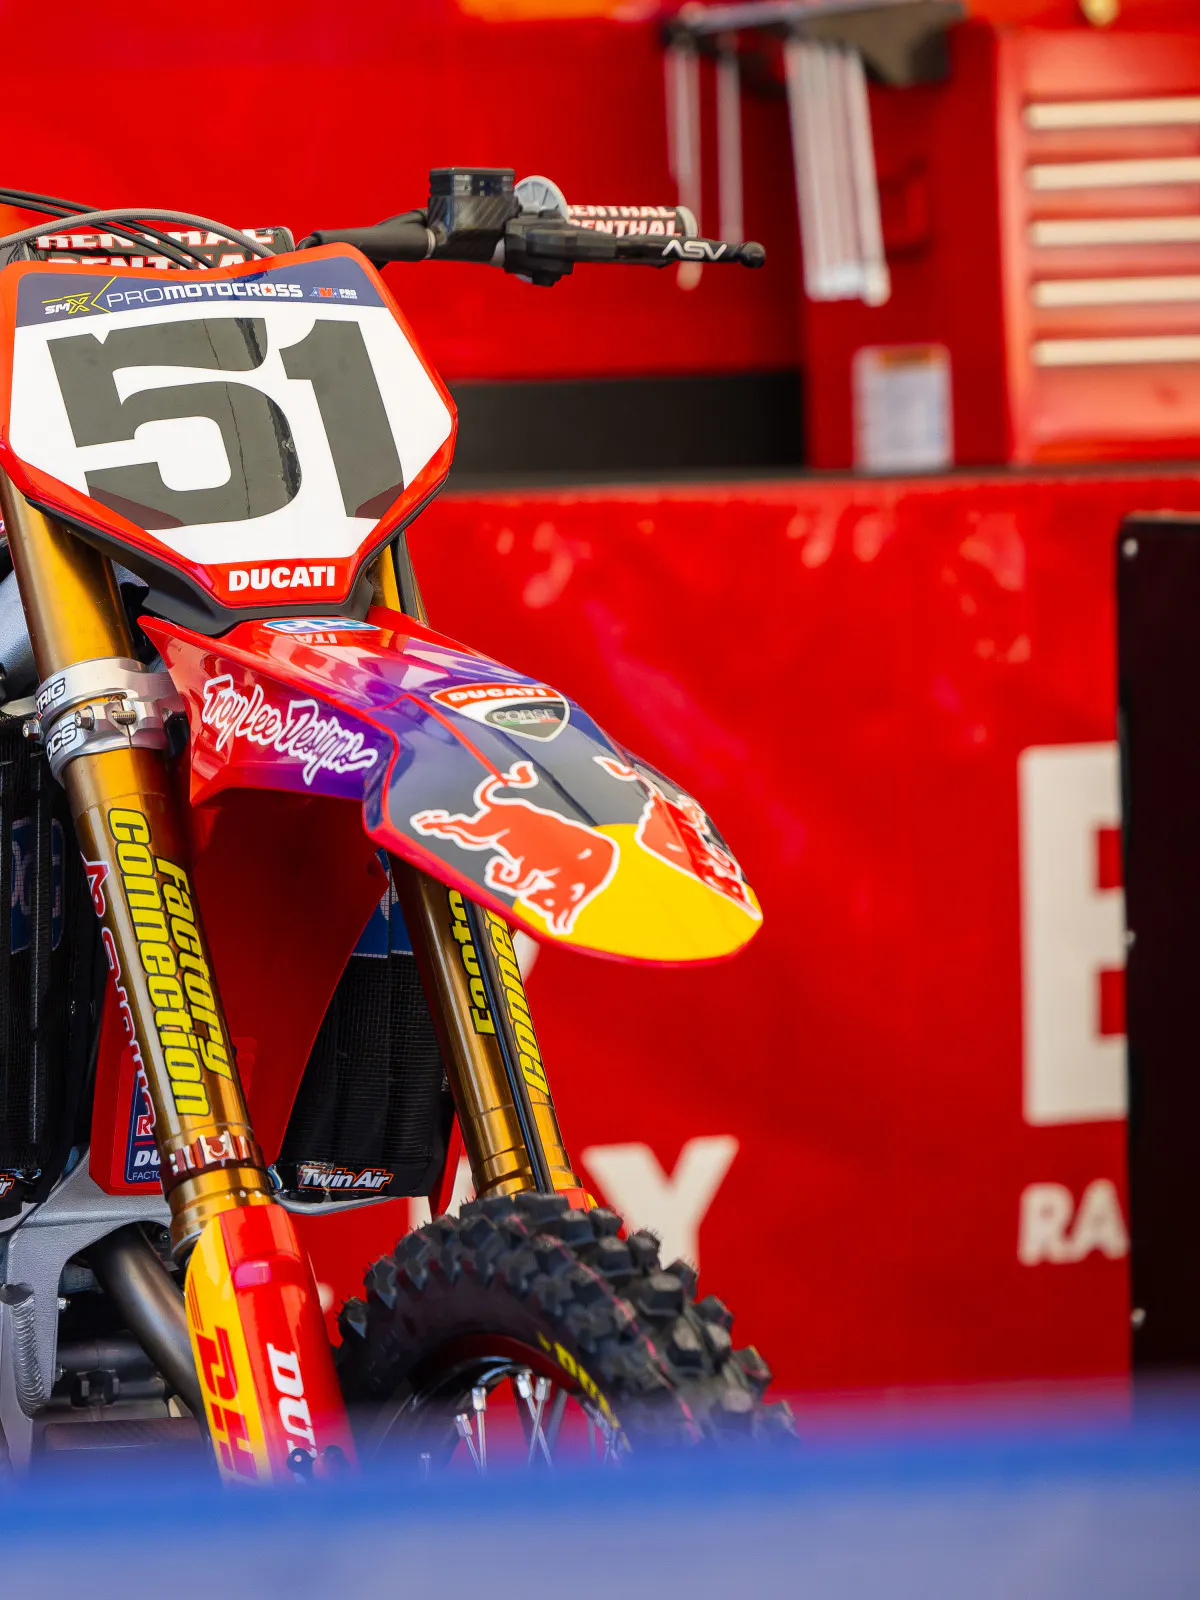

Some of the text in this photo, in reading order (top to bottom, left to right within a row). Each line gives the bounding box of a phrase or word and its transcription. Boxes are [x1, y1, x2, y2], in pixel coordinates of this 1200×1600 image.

[662, 239, 727, 261] ASV
[44, 297, 91, 315] SMX
[46, 316, 405, 531] 51
[228, 565, 335, 592] DUCATI
[447, 687, 548, 702] DUCATI
[492, 708, 557, 722] CORSE
[301, 1167, 391, 1189] Twin Air
